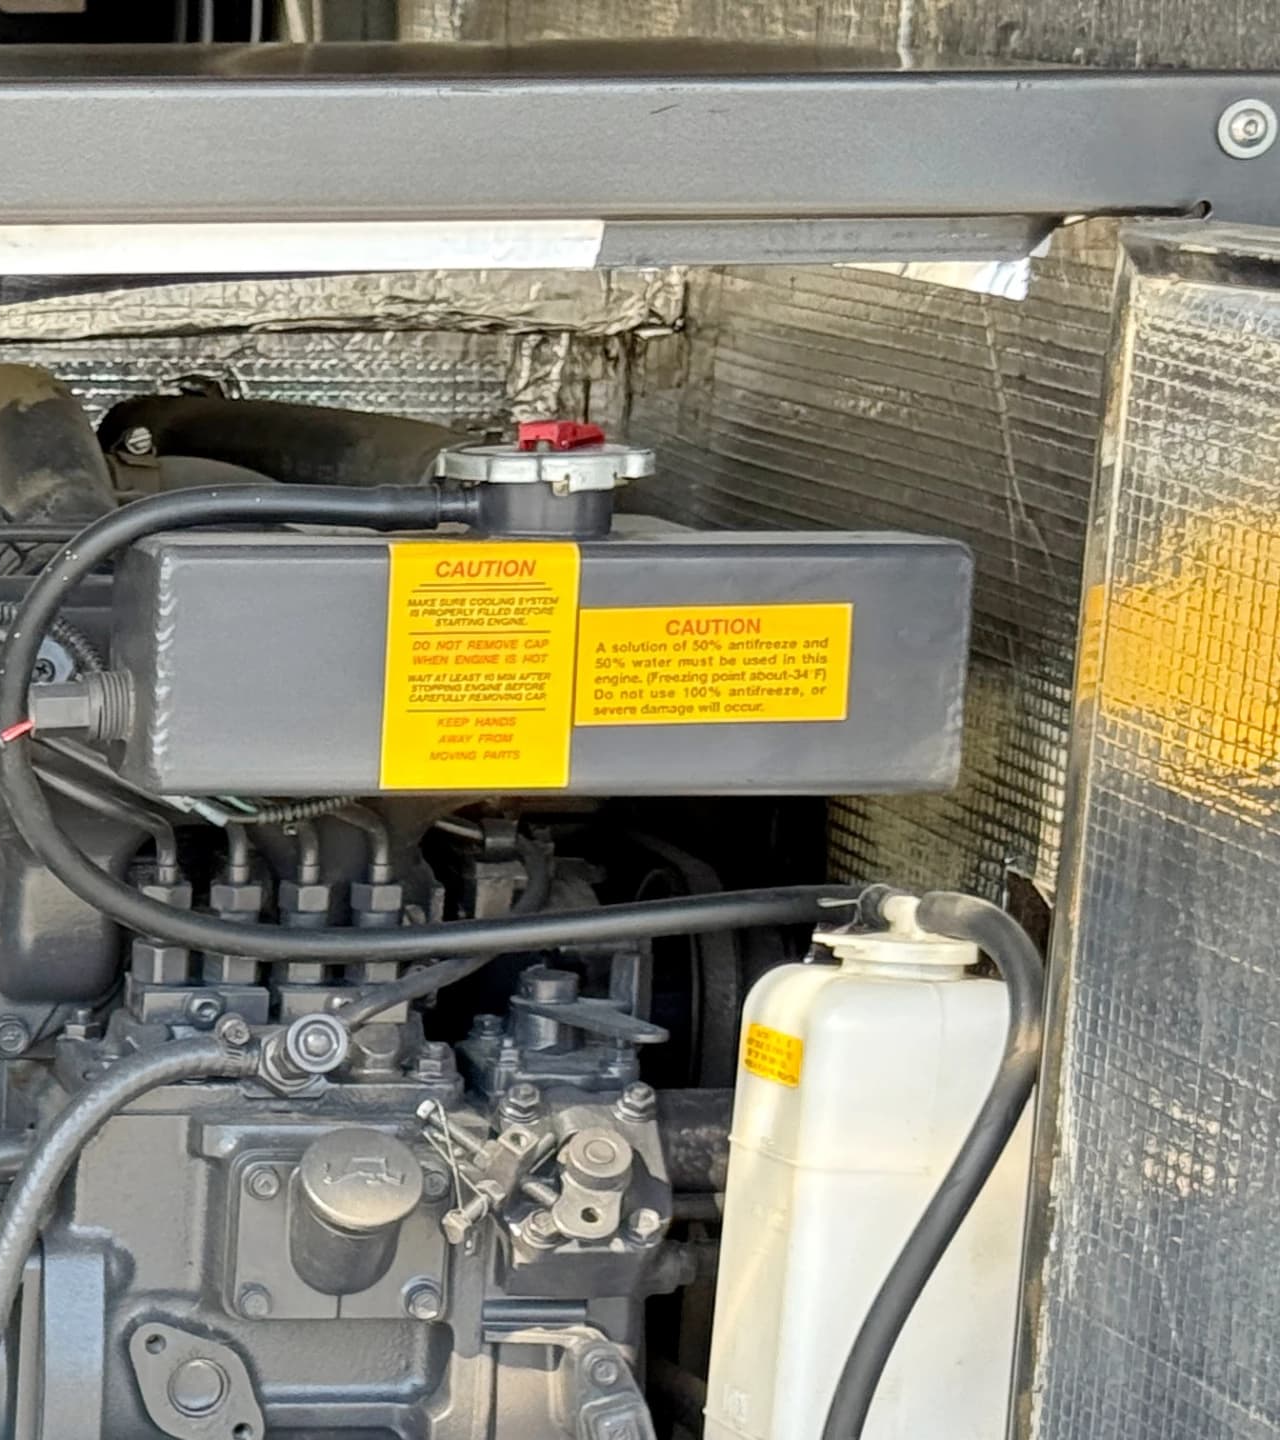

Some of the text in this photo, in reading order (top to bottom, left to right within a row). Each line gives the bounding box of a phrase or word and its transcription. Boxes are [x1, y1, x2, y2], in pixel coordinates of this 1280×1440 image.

[436, 560, 536, 578] CAUTION
[439, 598, 467, 606] SURE
[469, 597, 515, 606] COOLING
[519, 597, 559, 605] SYSTEM
[421, 608, 474, 617] PROPERLY
[436, 617, 484, 626] STARTING
[666, 618, 761, 636] CAUTION
[412, 640, 549, 651] DO NOT REMOVE CAP
[596, 637, 829, 653] A solution of 50% antifreeze and
[413, 654, 548, 664] WHEN ENGINE IS HOT
[595, 653, 827, 669] 50% water must be used in this
[450, 673, 482, 682] LEAST
[594, 673, 642, 687] engine.
[647, 671, 707, 686] (Freezing
[711, 671, 746, 683] point
[411, 684, 461, 692] STOPPING
[464, 683, 503, 692] ENGINE
[594, 685, 826, 700] Do not use 100% antifreeze, or
[409, 693, 466, 702] CAREFULLY
[469, 693, 522, 702] REMOVING
[593, 703, 765, 716] severe damage will occur.
[437, 717, 516, 727] KEEP HANDS
[438, 734, 513, 744] AWAY FROM
[430, 751, 520, 760] MOVING PARTS
